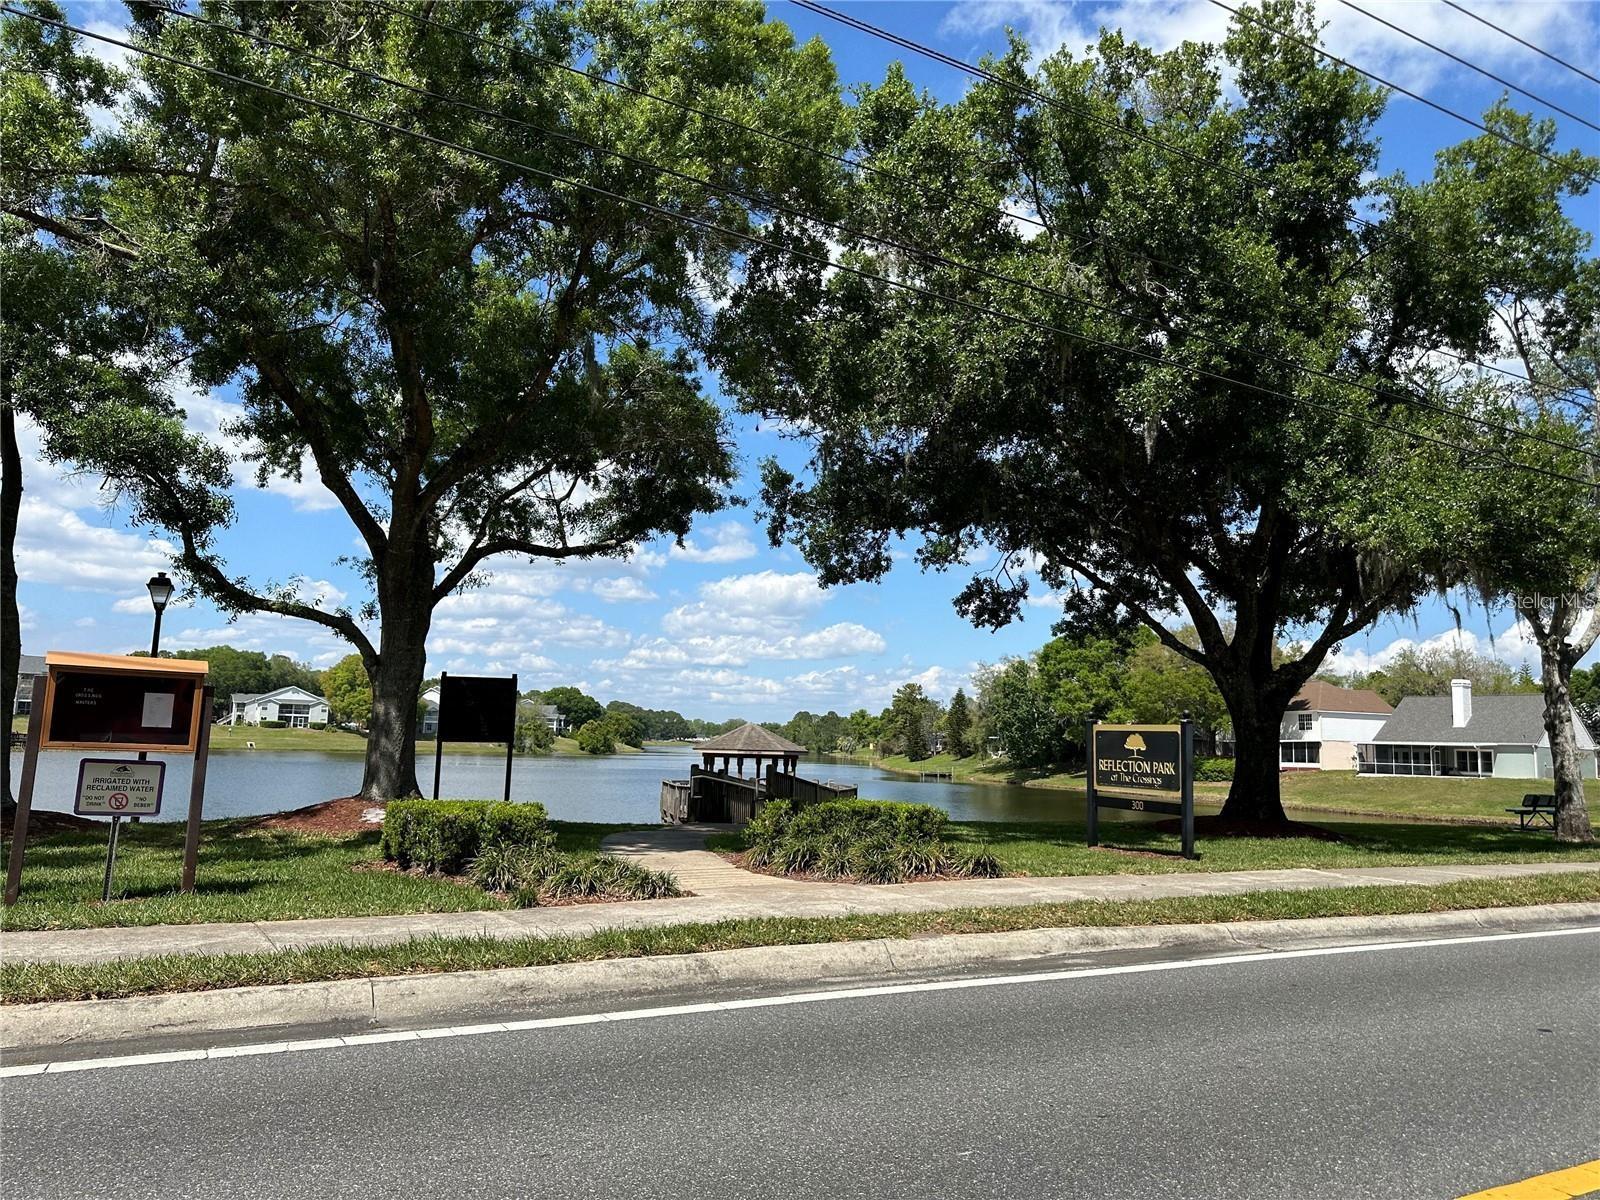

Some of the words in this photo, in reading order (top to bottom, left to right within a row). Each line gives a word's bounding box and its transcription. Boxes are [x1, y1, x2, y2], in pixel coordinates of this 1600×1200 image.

[1098, 758, 1151, 773] REFLECTION
[1153, 761, 1176, 775] PARK
[92, 777, 131, 785] IRRIGATED
[1110, 774, 1118, 782] at
[1120, 772, 1132, 783] The
[1132, 774, 1162, 788] Crossings
[86, 784, 128, 792] RECLAIMED
[1131, 800, 1144, 810] 300
